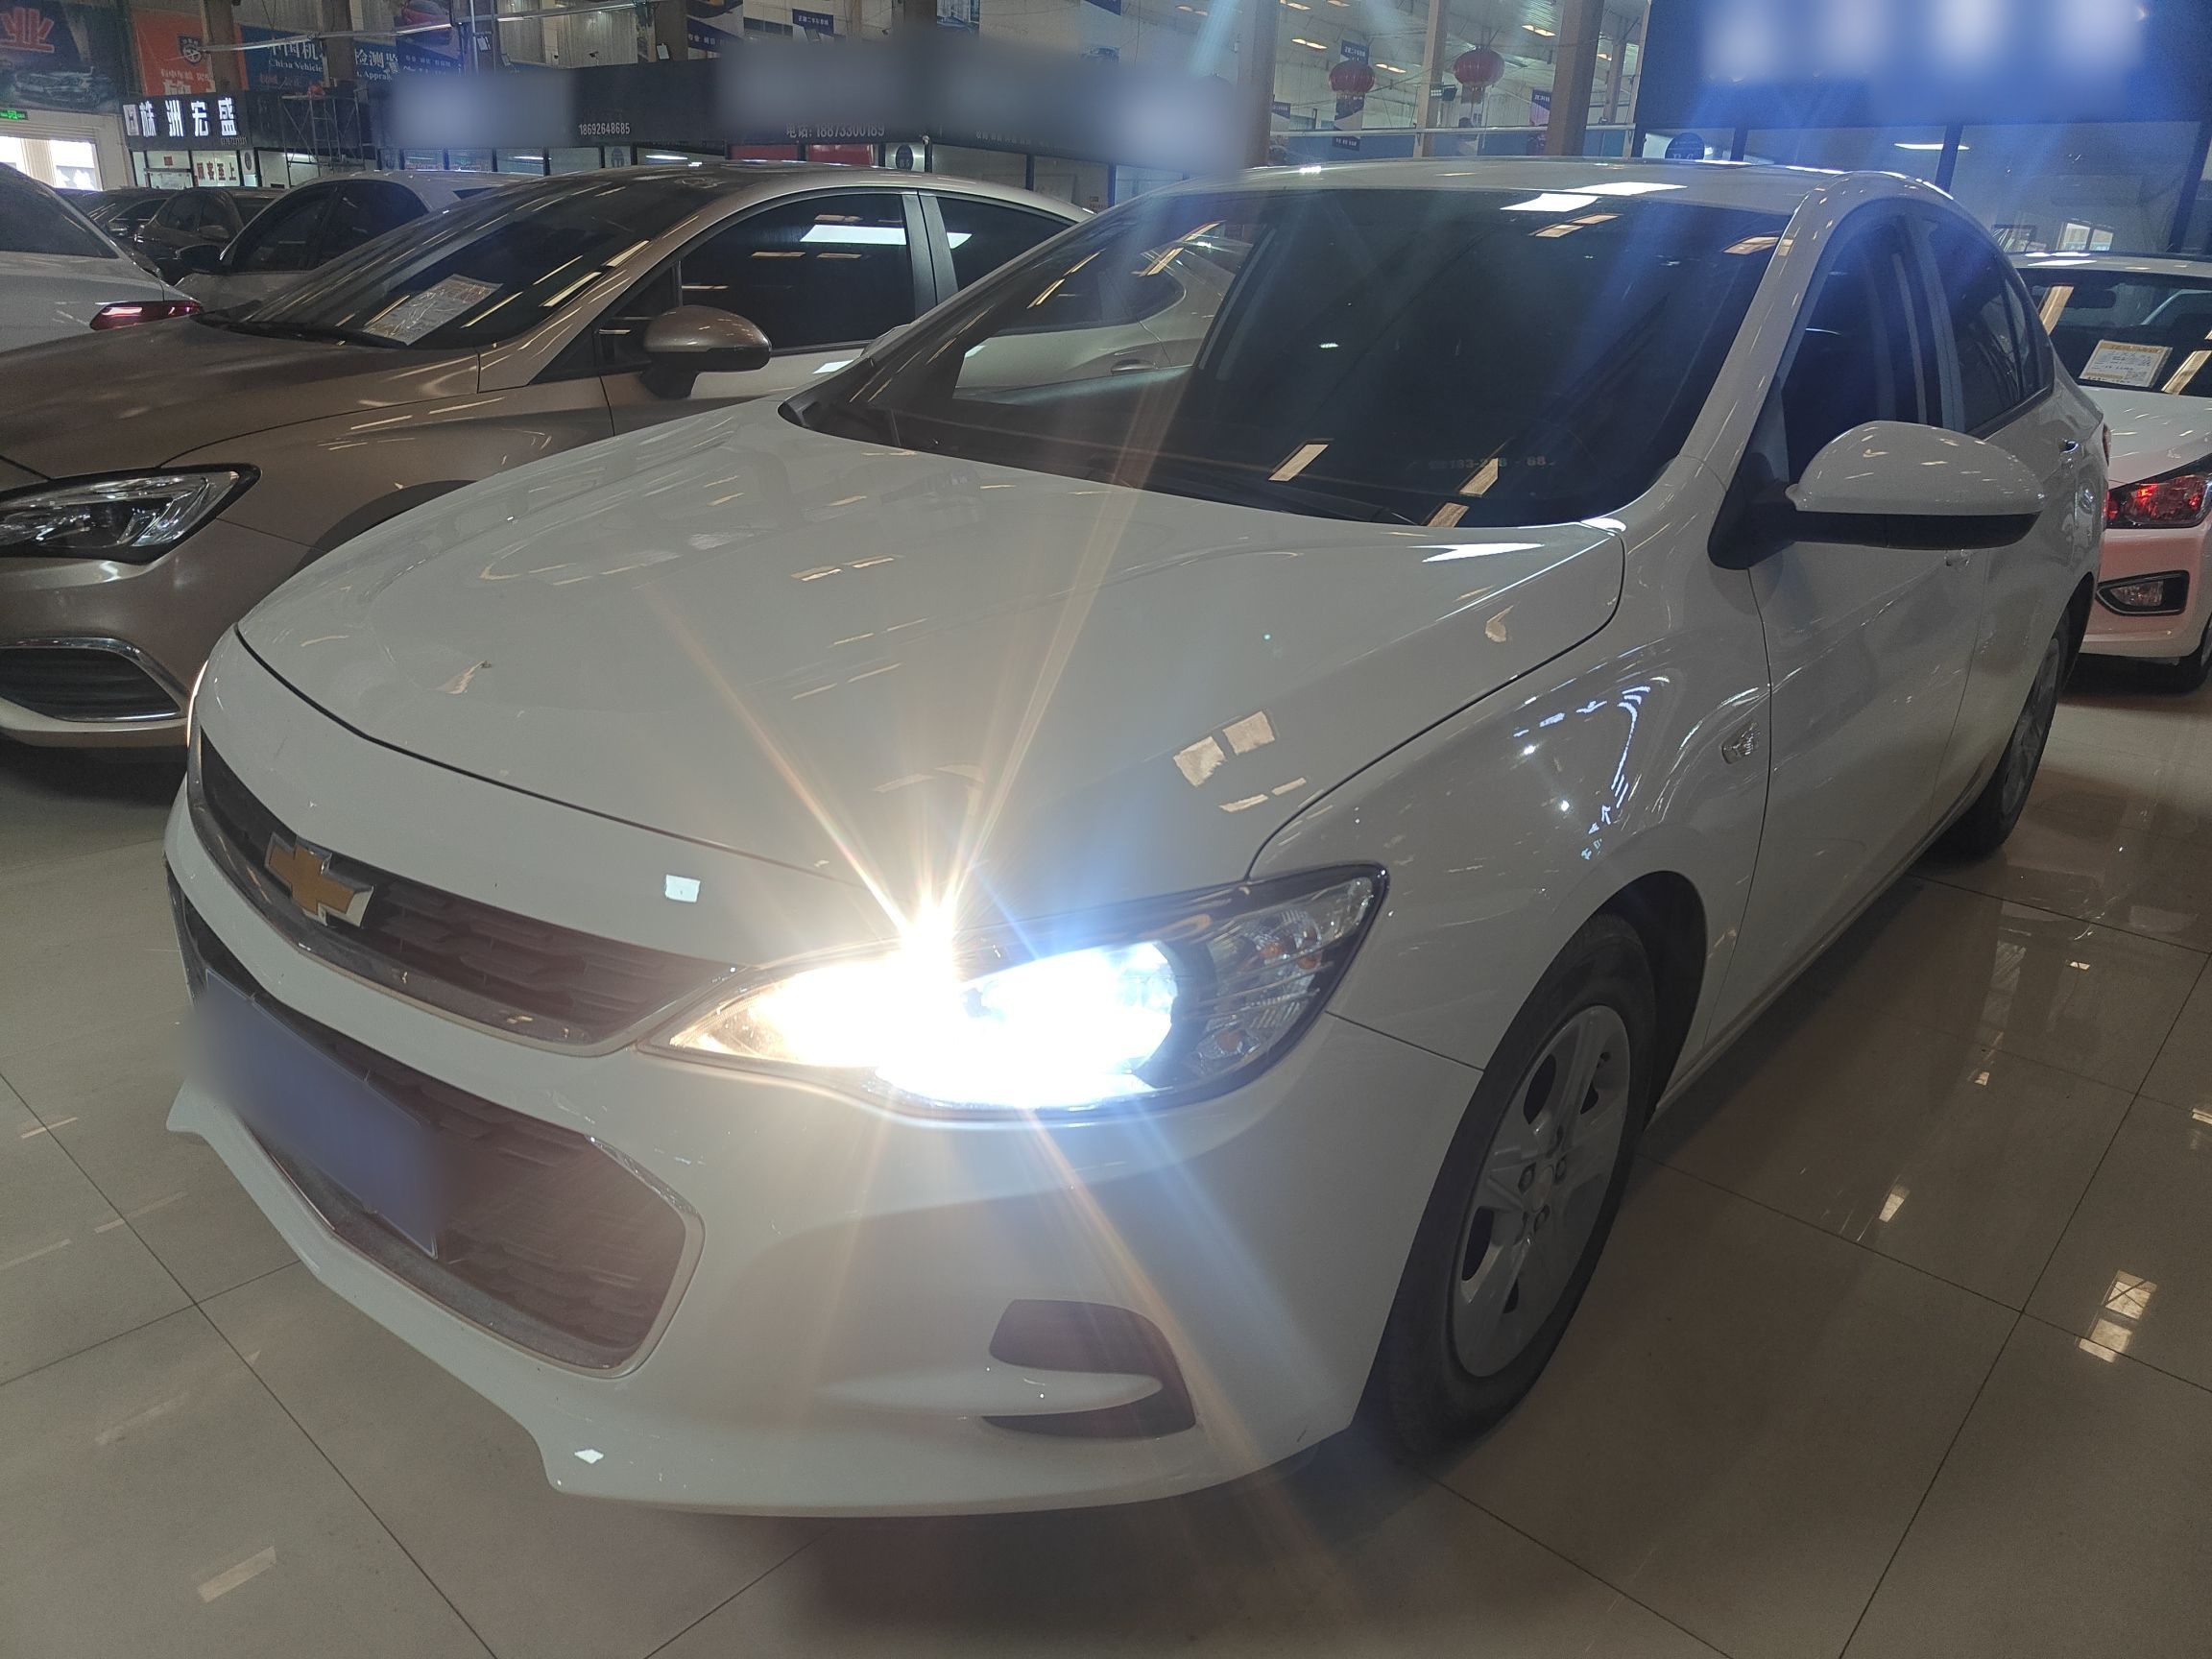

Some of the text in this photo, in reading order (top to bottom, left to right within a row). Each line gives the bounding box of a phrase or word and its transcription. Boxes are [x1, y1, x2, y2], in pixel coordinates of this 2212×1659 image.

[295, 61, 324, 73] Vehicle
[139, 97, 237, 137] 株洲宏盛
[578, 123, 630, 135] 18692648685
[816, 122, 885, 137] 18873300189
[196, 161, 237, 180] 顾客至上
